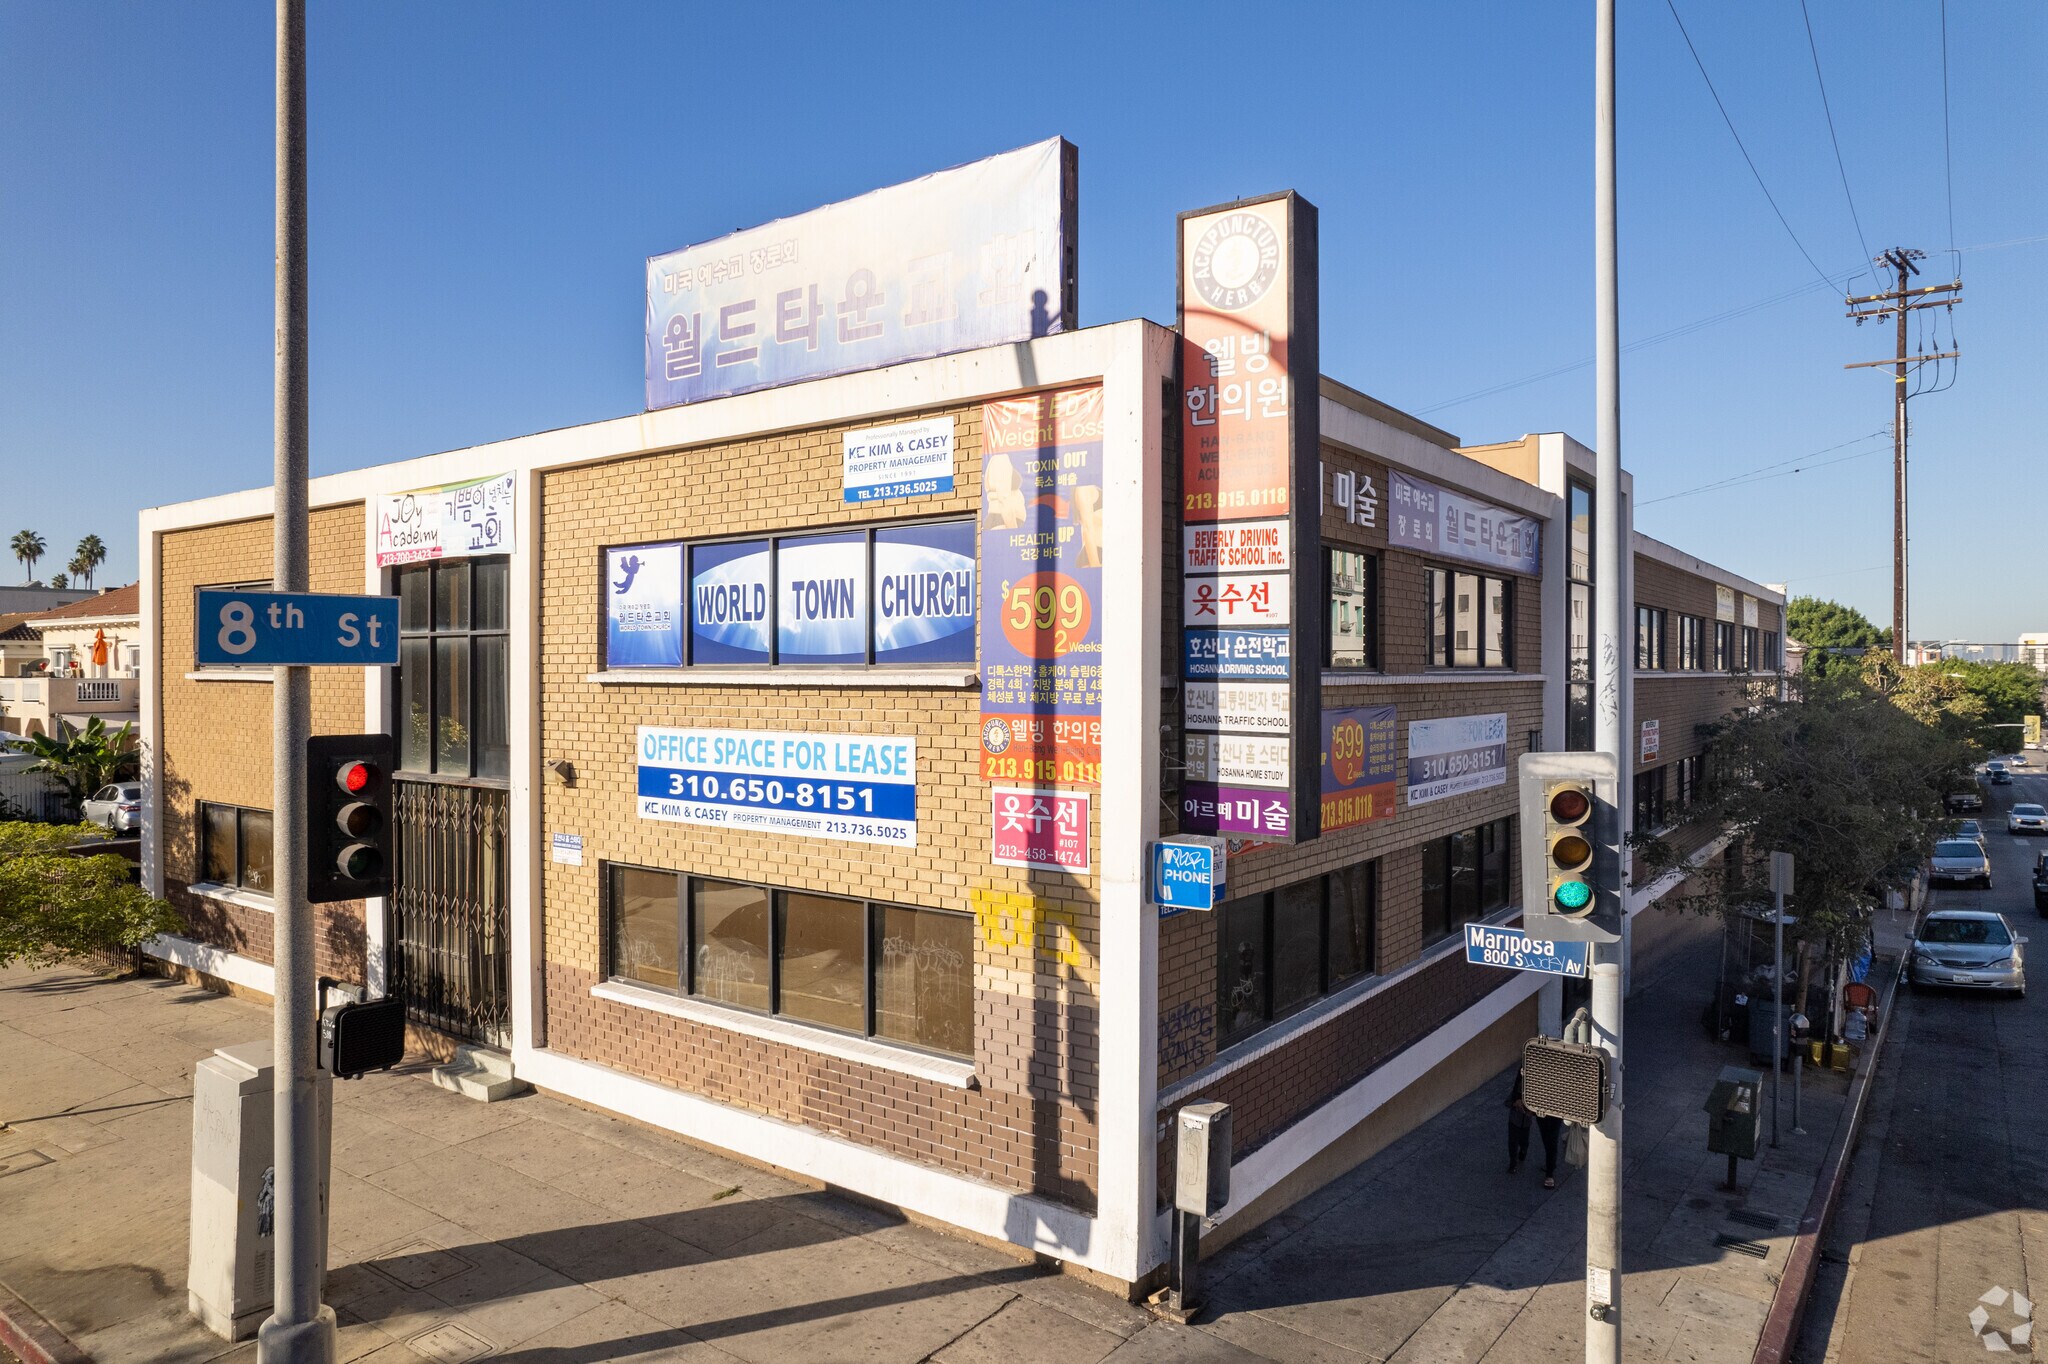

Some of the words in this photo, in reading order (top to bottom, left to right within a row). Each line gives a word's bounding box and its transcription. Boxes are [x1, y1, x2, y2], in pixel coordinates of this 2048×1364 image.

[1194, 214, 1278, 279] ACUPUNCTURE
[664, 268, 693, 296] 미국
[697, 254, 744, 287] 예수교
[749, 239, 799, 275] 장로회
[1211, 283, 1263, 306] HERB
[1203, 329, 1270, 378] 웰빙
[1001, 393, 1099, 425] SPEEDY
[1186, 375, 1288, 427] 한의원
[868, 443, 892, 457] KIM
[895, 441, 904, 453] &
[908, 435, 949, 452] CASEY
[988, 423, 1054, 449] Weight
[848, 461, 887, 473] PROPERTY
[889, 452, 948, 468] MANAGEMENT
[1025, 458, 1060, 474] TOXIN
[1063, 450, 1088, 468] OUT
[878, 473, 898, 481] SINCE
[900, 470, 917, 478] 1991
[1034, 475, 1055, 489] 독소
[1057, 472, 1078, 487] 배출
[858, 489, 872, 500] TEL
[873, 480, 938, 498] 213.736.5025
[1186, 486, 1288, 511] 213.915.0118
[1395, 482, 1412, 507] 미국
[1412, 488, 1436, 514] 예수교
[445, 484, 486, 522] 기쁨이
[380, 511, 439, 552] Academy
[468, 505, 503, 551] 교회
[1009, 532, 1055, 548] HEALTH
[1057, 525, 1075, 543] UP
[1194, 529, 1236, 549] BEVERLY
[1240, 527, 1279, 547] DRIVING
[1445, 504, 1537, 564] 월드타운교회
[1020, 547, 1040, 561] 건강
[1043, 545, 1063, 560] 바디
[1188, 548, 1226, 567] TRAFFIC
[1228, 547, 1266, 566] SCHOOL
[1268, 546, 1285, 565] inc.
[697, 583, 767, 624] WORLD
[791, 577, 855, 622] TOWN
[880, 569, 972, 620] CHURCH
[1191, 581, 1270, 617] 옷수선
[218, 601, 304, 655] 8th
[337, 612, 383, 648] St
[619, 610, 671, 623] 월드타운교회
[1054, 629, 1067, 654] 2
[1068, 640, 1102, 653] Weeks
[1189, 636, 1231, 659] 호산나
[1233, 635, 1290, 659] 운전학교
[1190, 664, 1224, 674] HOSANNA
[1225, 664, 1254, 675] DRIVING
[1255, 664, 1288, 676] SCHOOL
[987, 679, 1006, 691] 경락
[1008, 678, 1023, 690] 4회
[1033, 679, 1051, 691] 지방
[1054, 679, 1074, 691] 분해
[1017, 691, 1027, 704] 및
[1062, 692, 1083, 705] 무료
[1187, 688, 1215, 710] 호산나
[1271, 690, 1290, 712] 학교
[983, 719, 1010, 742] ACUPUNCTURE
[1011, 719, 1044, 743] 웰빙
[1187, 713, 1222, 725] HOSANNA
[1224, 715, 1255, 726] TRAFFIC
[1257, 716, 1289, 728] SCHOOL
[643, 733, 708, 763] OFFICE
[713, 736, 776, 769] SPACE
[782, 740, 827, 771] FOR
[834, 742, 907, 776] LEASE
[987, 742, 1005, 754] HERB
[1212, 741, 1242, 764] 호산나
[1245, 743, 1255, 765] 홈
[1217, 767, 1245, 777] HOSANNA
[1245, 769, 1263, 780] HOME
[1264, 771, 1284, 781] STUDY
[1347, 762, 1353, 780] 2
[1423, 749, 1496, 779] 310.650-8151
[668, 773, 874, 812] 310.650-8151
[1434, 783, 1449, 796] CASEY
[661, 804, 682, 818] KIM
[684, 805, 692, 818] &
[694, 807, 729, 822] CASEY
[733, 813, 768, 825] PROPERTY
[769, 816, 822, 830] MANAGEMENT
[826, 821, 907, 840] 213.736.5025
[999, 795, 1079, 837] 옷수선
[1235, 798, 1290, 831] 미술
[1320, 793, 1373, 829] 213.915.0118
[998, 843, 1082, 866] 213-458-1474
[1058, 839, 1079, 849] #107
[1164, 869, 1211, 884] PHONE
[1470, 927, 1555, 957] Mariposa
[1483, 948, 1509, 965] 800
[1565, 959, 1582, 974] Av
